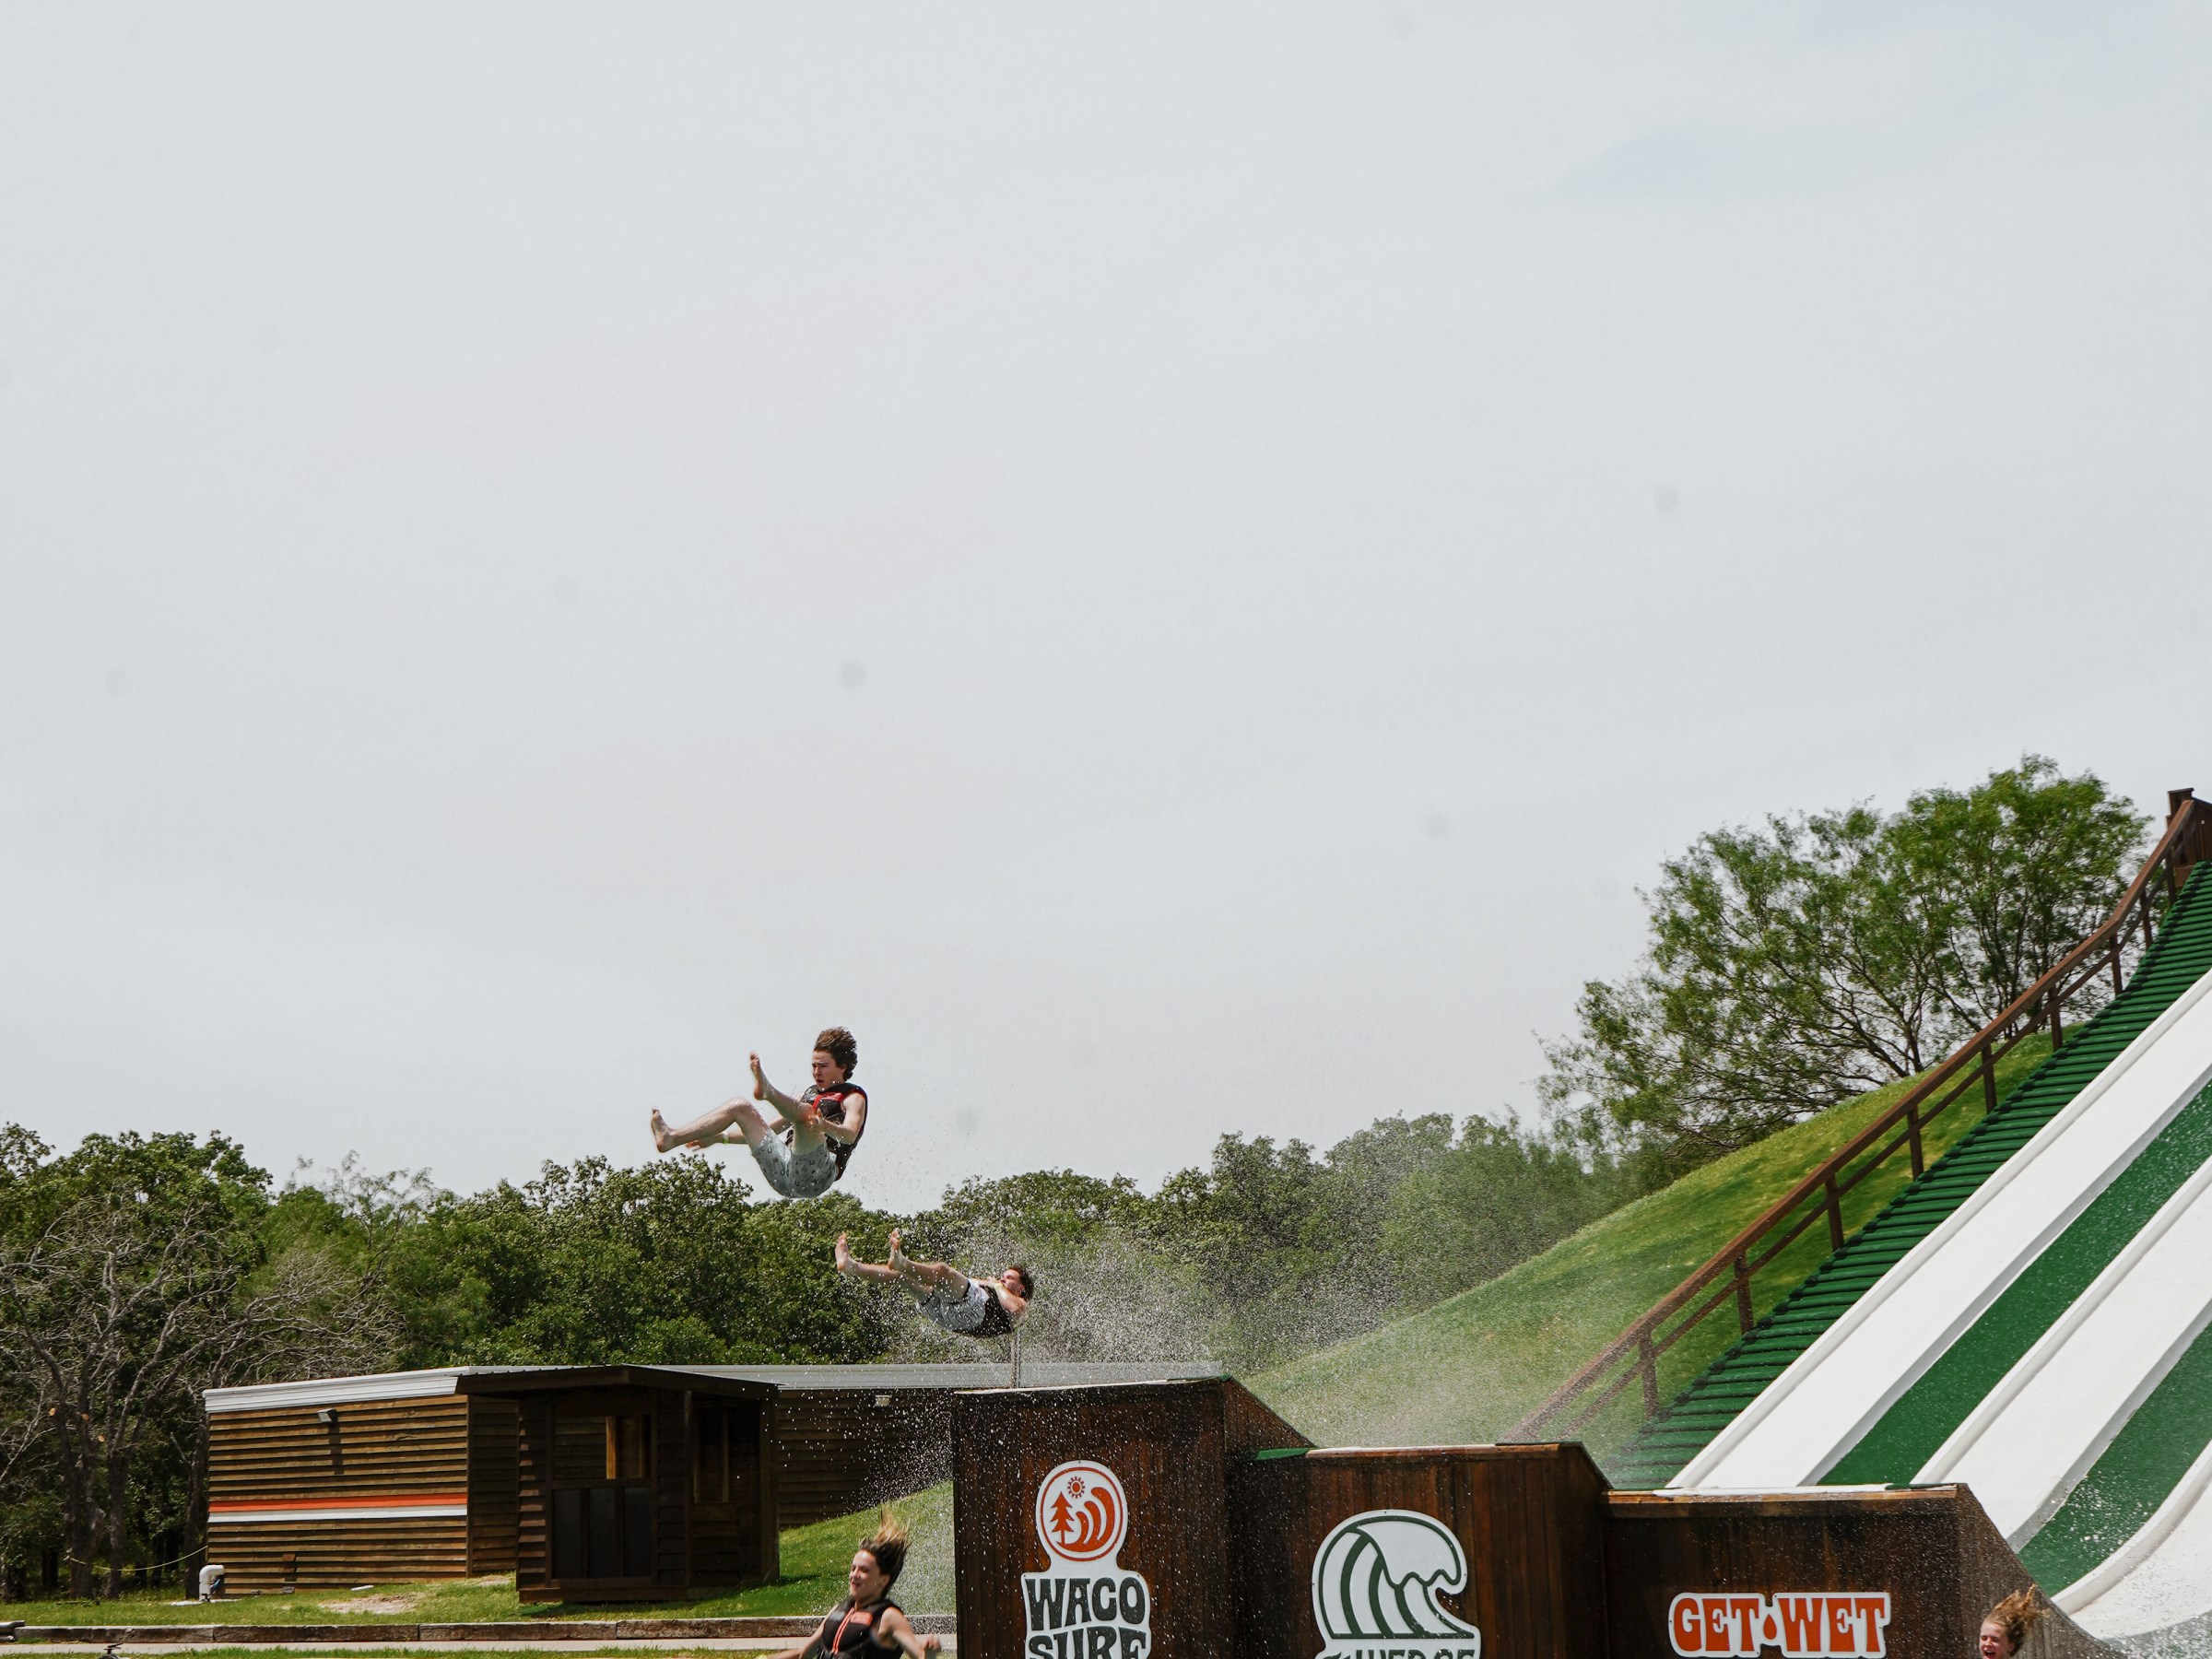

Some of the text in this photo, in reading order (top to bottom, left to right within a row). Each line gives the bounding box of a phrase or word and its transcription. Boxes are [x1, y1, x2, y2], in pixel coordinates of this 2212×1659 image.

[1025, 1577, 1146, 1630] WACO
[1674, 1597, 1885, 1653] GET WET
